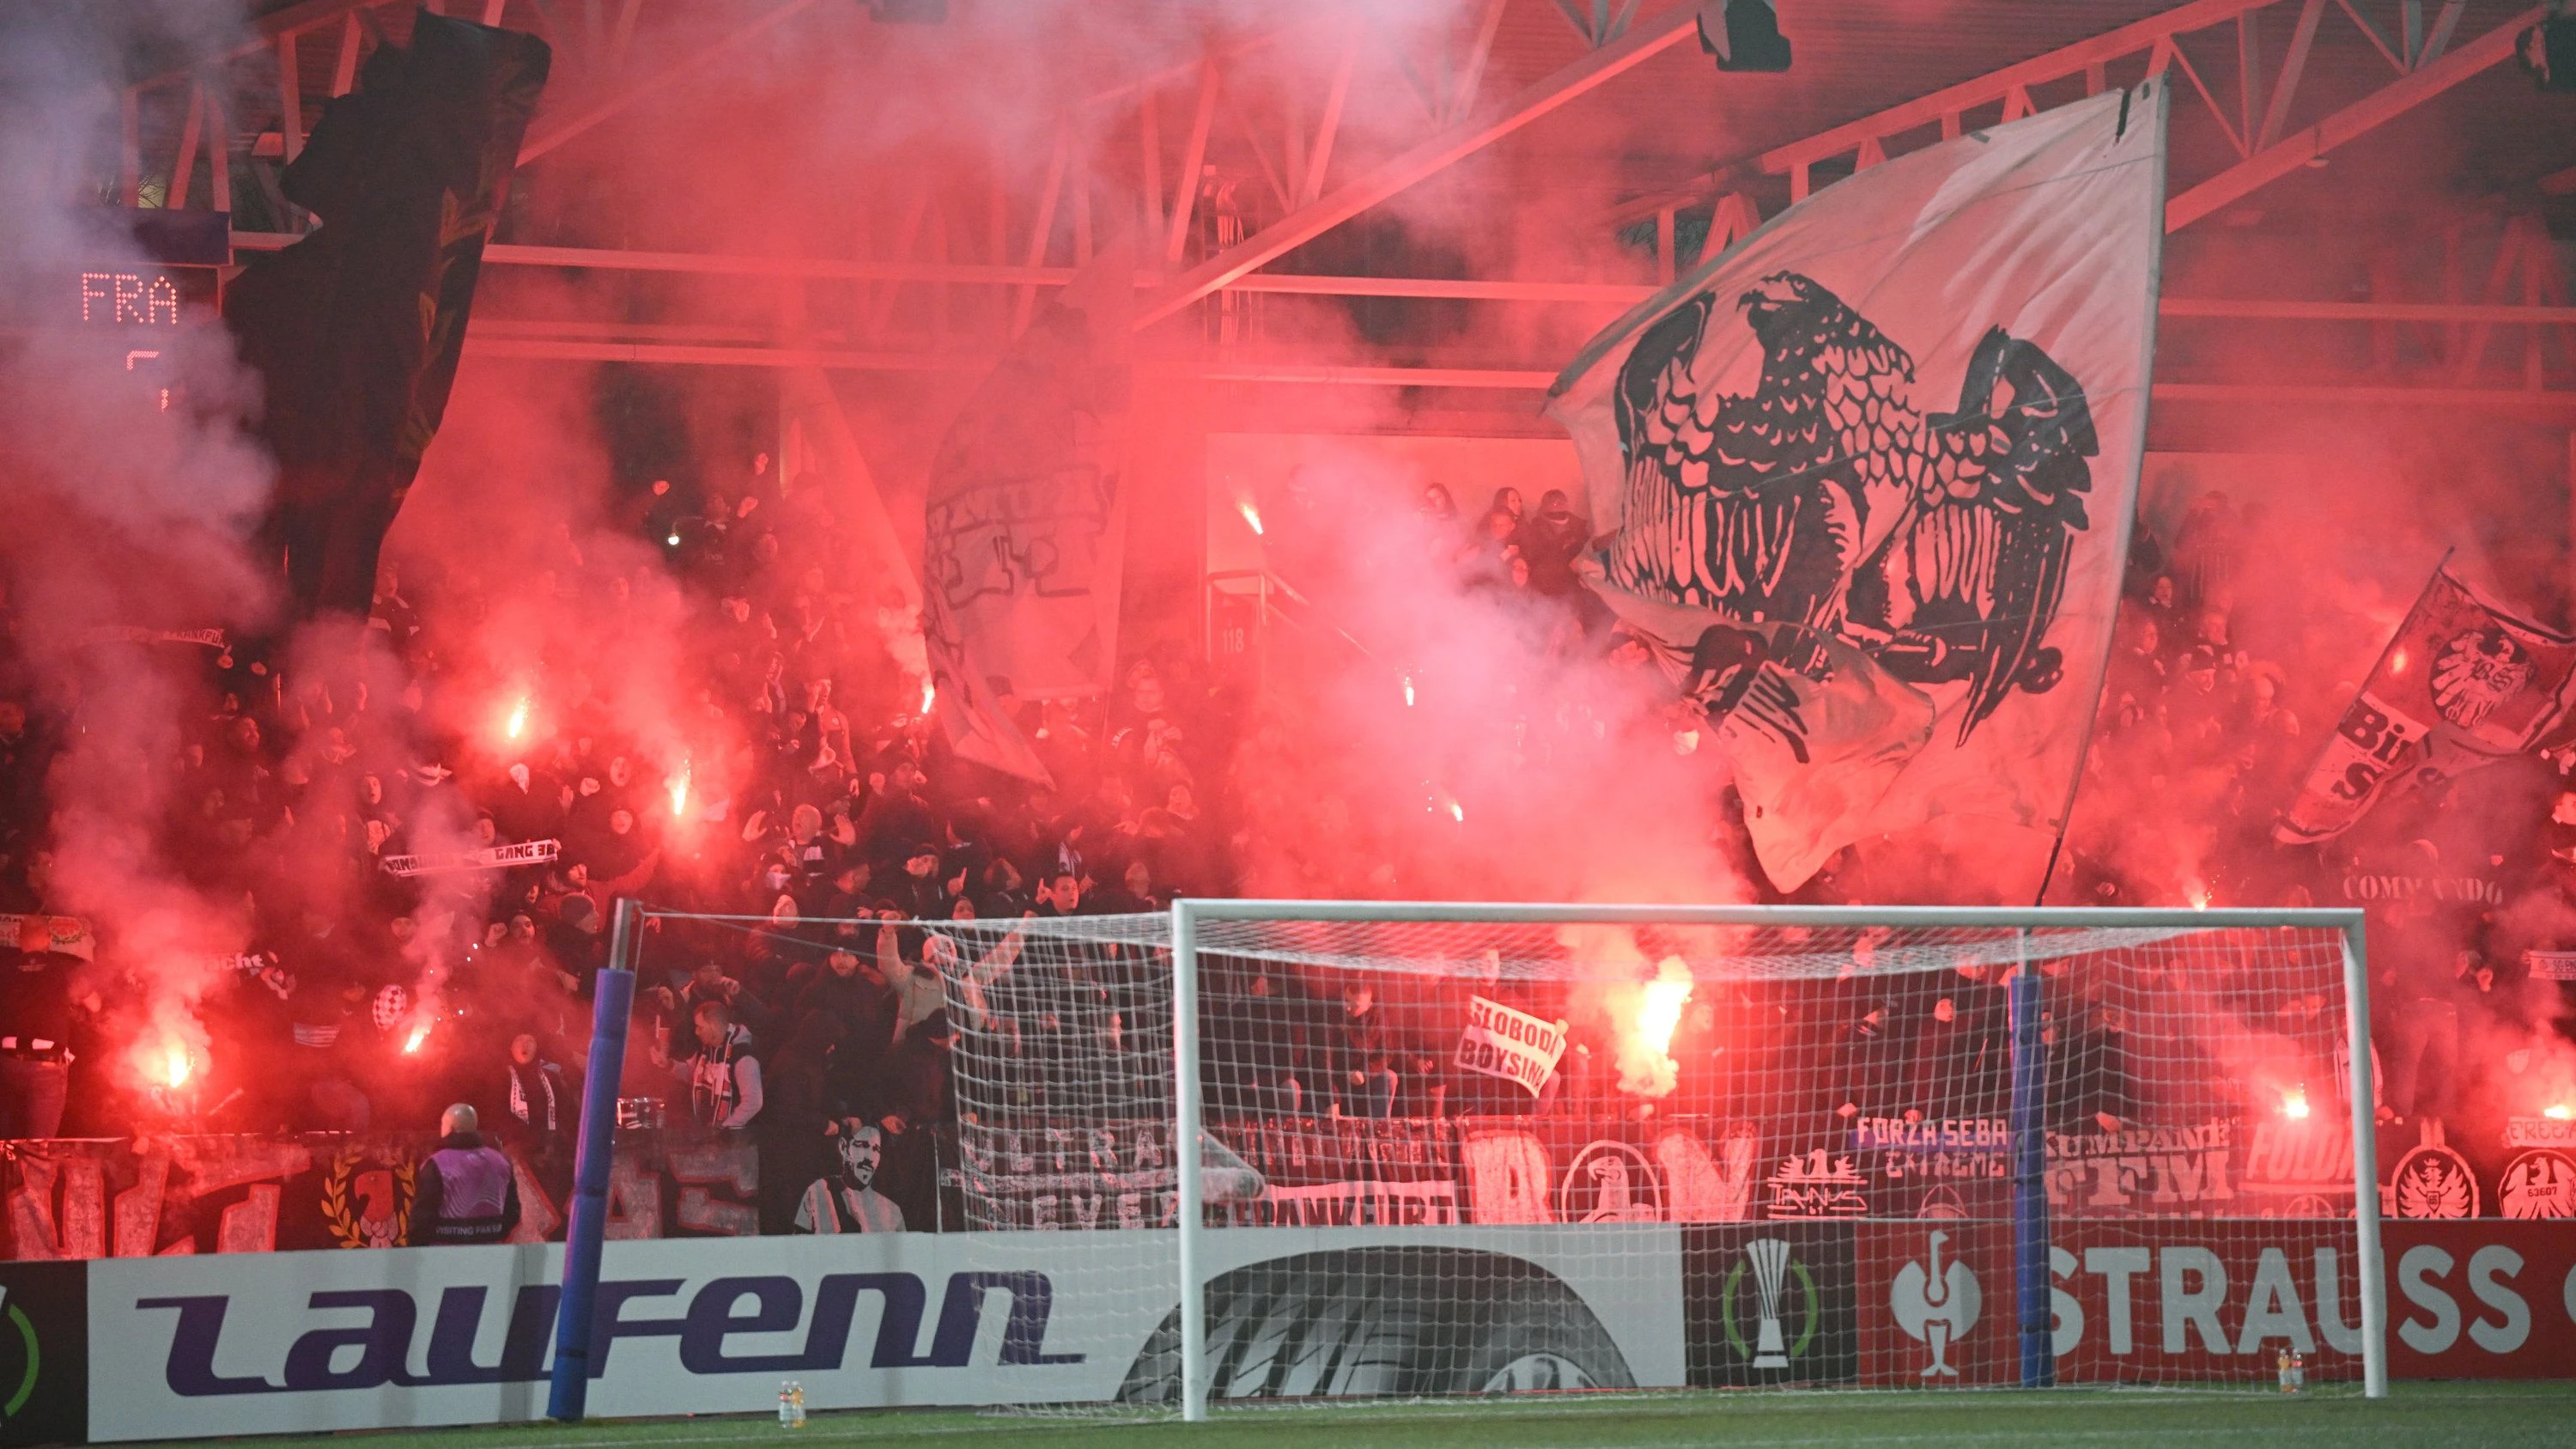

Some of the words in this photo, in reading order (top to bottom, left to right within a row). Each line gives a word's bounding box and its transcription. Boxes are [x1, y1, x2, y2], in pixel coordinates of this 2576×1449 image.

[82, 272, 177, 325] FRA
[1223, 627, 1244, 653] 118
[495, 844, 533, 861] GANG
[1857, 1117, 1937, 1146] FORZA
[1942, 1119, 2007, 1147] SEBA
[2049, 1244, 2532, 1355] STRAUSS
